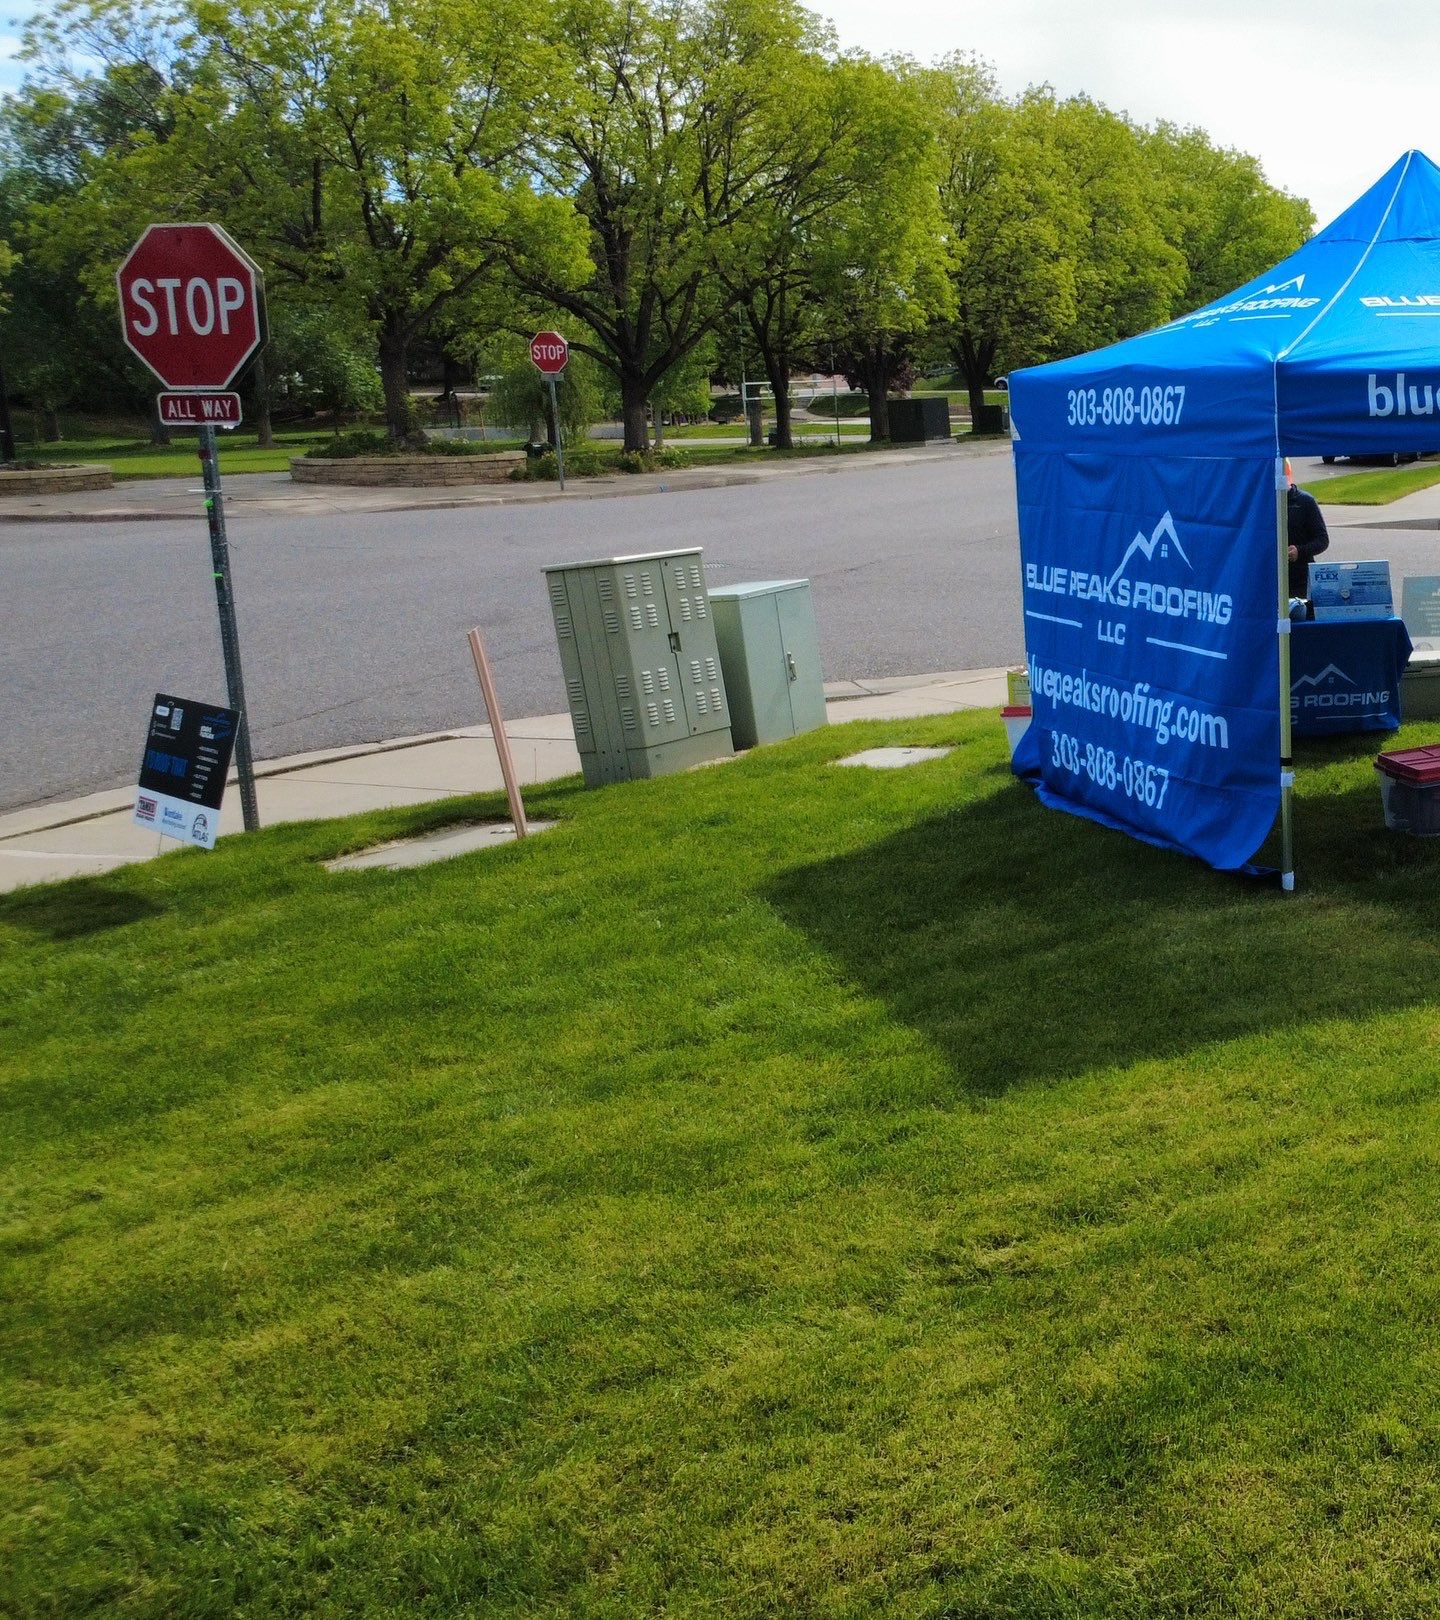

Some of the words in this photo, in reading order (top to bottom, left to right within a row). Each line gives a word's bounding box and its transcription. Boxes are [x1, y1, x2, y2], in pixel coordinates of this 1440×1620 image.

[130, 276, 245, 337] STOP
[532, 345, 564, 360] STOP
[168, 400, 196, 418] ALL
[201, 400, 232, 418] WAY
[1067, 385, 1186, 426] 303-808-0867
[1314, 572, 1339, 581] FLEX
[1026, 563, 1068, 595] BLUE
[1069, 570, 1131, 607] PEAKS
[1133, 581, 1233, 626] ROOFING
[1097, 619, 1127, 646] LLC
[1304, 690, 1391, 708] ROOFING
[1051, 730, 1170, 810] 303-808-0867
